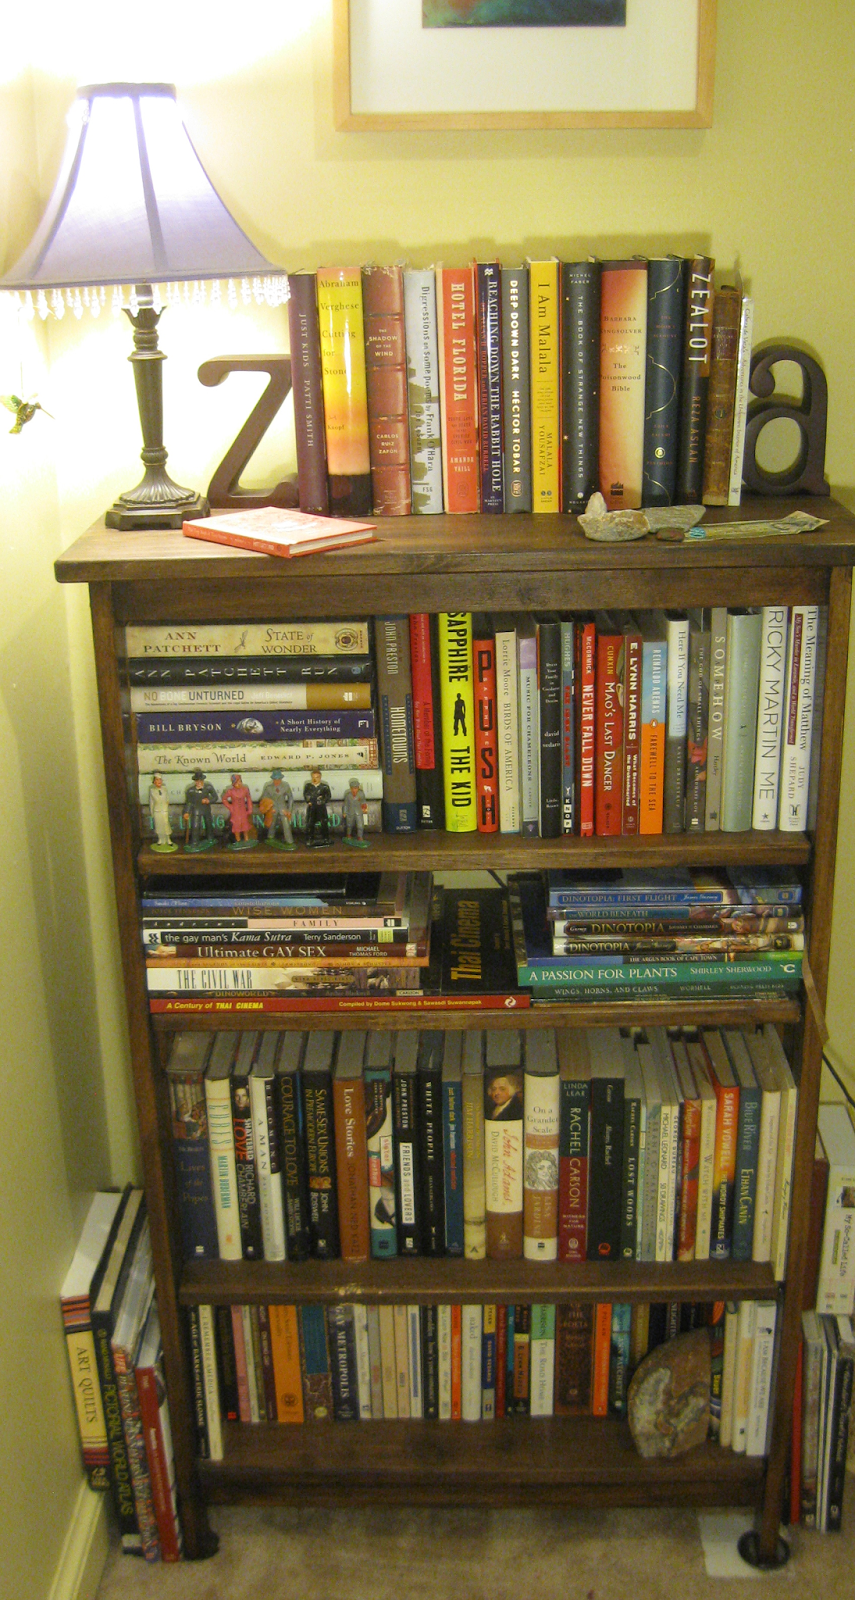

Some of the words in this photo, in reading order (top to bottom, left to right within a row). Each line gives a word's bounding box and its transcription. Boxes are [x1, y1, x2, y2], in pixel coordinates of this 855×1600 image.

[319, 280, 359, 288] Abraham
[510, 280, 518, 308] DEEP
[320, 302, 360, 312] Verghese
[451, 283, 466, 330] HOTEL
[488, 281, 499, 344] REACHING
[538, 295, 550, 318] Am
[689, 274, 711, 364] ZEALOT
[299, 313, 308, 338] JUST
[510, 312, 519, 347] DOWN
[301, 342, 309, 368] KIDS
[538, 325, 551, 373] Malala
[578, 352, 584, 363] OF
[452, 339, 467, 401] FLORIDA
[490, 347, 499, 383] DOWN
[511, 350, 520, 380] DARK
[490, 386, 500, 411] THE
[691, 396, 700, 422] REZA
[491, 414, 500, 456] RABBIT
[689, 430, 699, 463] ASLAN
[492, 460, 501, 492] HOLE
[385, 622, 396, 641] JOHN
[806, 607, 818, 631] The
[165, 632, 197, 640] ANN
[262, 645, 317, 653] WONDER
[630, 643, 638, 653] E.
[766, 610, 784, 672] RICKY
[185, 667, 287, 677] PATCHETT
[386, 643, 398, 675] PRESTON
[629, 658, 638, 690] LYNN
[677, 662, 686, 678] You
[801, 635, 816, 684] Meaning
[144, 692, 158, 700] NO
[160, 691, 187, 700] BONE
[189, 691, 244, 700] UNTURNED
[582, 684, 594, 720] NEVER
[604, 682, 616, 717] MAO'S
[712, 636, 725, 740] SOMEHOW
[802, 690, 812, 700] of
[629, 694, 637, 740] HARRIS
[677, 706, 684, 718] Me
[762, 680, 780, 758] MARTIN
[800, 703, 812, 750] Matthew
[390, 706, 408, 764] HOMETOWNS
[505, 734, 512, 745] OF
[582, 726, 593, 753] FALL
[604, 722, 614, 746] LAST
[155, 755, 172, 765] The
[175, 755, 211, 765] Known
[212, 753, 247, 763] World
[450, 746, 470, 774] THE
[649, 735, 658, 768] FAREWELL
[505, 749, 513, 792] AMERICA
[582, 757, 593, 787] DOWN
[603, 751, 616, 791] DANCER
[759, 772, 775, 799] ME
[788, 756, 796, 799] SHEPARD
[451, 782, 471, 807] KID
[232, 907, 272, 915] WISE
[281, 906, 342, 915] WOMEN
[450, 900, 481, 948] Cinema
[165, 934, 180, 942] the
[183, 935, 199, 944] gay
[231, 932, 260, 941] Kama
[264, 932, 292, 941] Sutra
[591, 923, 665, 933] DINOTOPIA
[198, 946, 259, 957] Ultimate
[262, 947, 294, 957] GAY
[298, 946, 326, 957] SEX
[569, 942, 630, 952] DINOTOPIA
[177, 970, 197, 989] THE
[202, 970, 229, 989] CIVIL
[232, 970, 252, 989] WAR
[451, 951, 482, 980] Thai
[529, 972, 538, 981] A
[542, 970, 594, 980] PASSION
[598, 969, 625, 979] FOR
[629, 968, 677, 978] PLANTS
[344, 1088, 354, 1115] Love
[723, 1093, 734, 1126] SARAH
[233, 1118, 248, 1160] LOVE
[345, 1118, 355, 1157] Stories
[570, 1107, 581, 1154] RACHEL
[403, 1145, 411, 1176] FRIENDS
[720, 1128, 732, 1169] VOWELL
[245, 1164, 256, 1205] RICHARD
[569, 1158, 581, 1208] CARSON
[741, 1168, 754, 1196] ETHAN
[311, 1192, 319, 1222] BOSWELL
[404, 1194, 412, 1221] LOVERS
[626, 1190, 634, 1227] WOODS
[739, 1197, 752, 1224] CANIN
[335, 1306, 345, 1326] GAY
[77, 1347, 91, 1372] ART
[337, 1331, 350, 1398] METROPOLIS
[78, 1377, 98, 1423] QUILTS
[112, 1442, 128, 1482] WORLD
[118, 1483, 134, 1515] ATLAS
